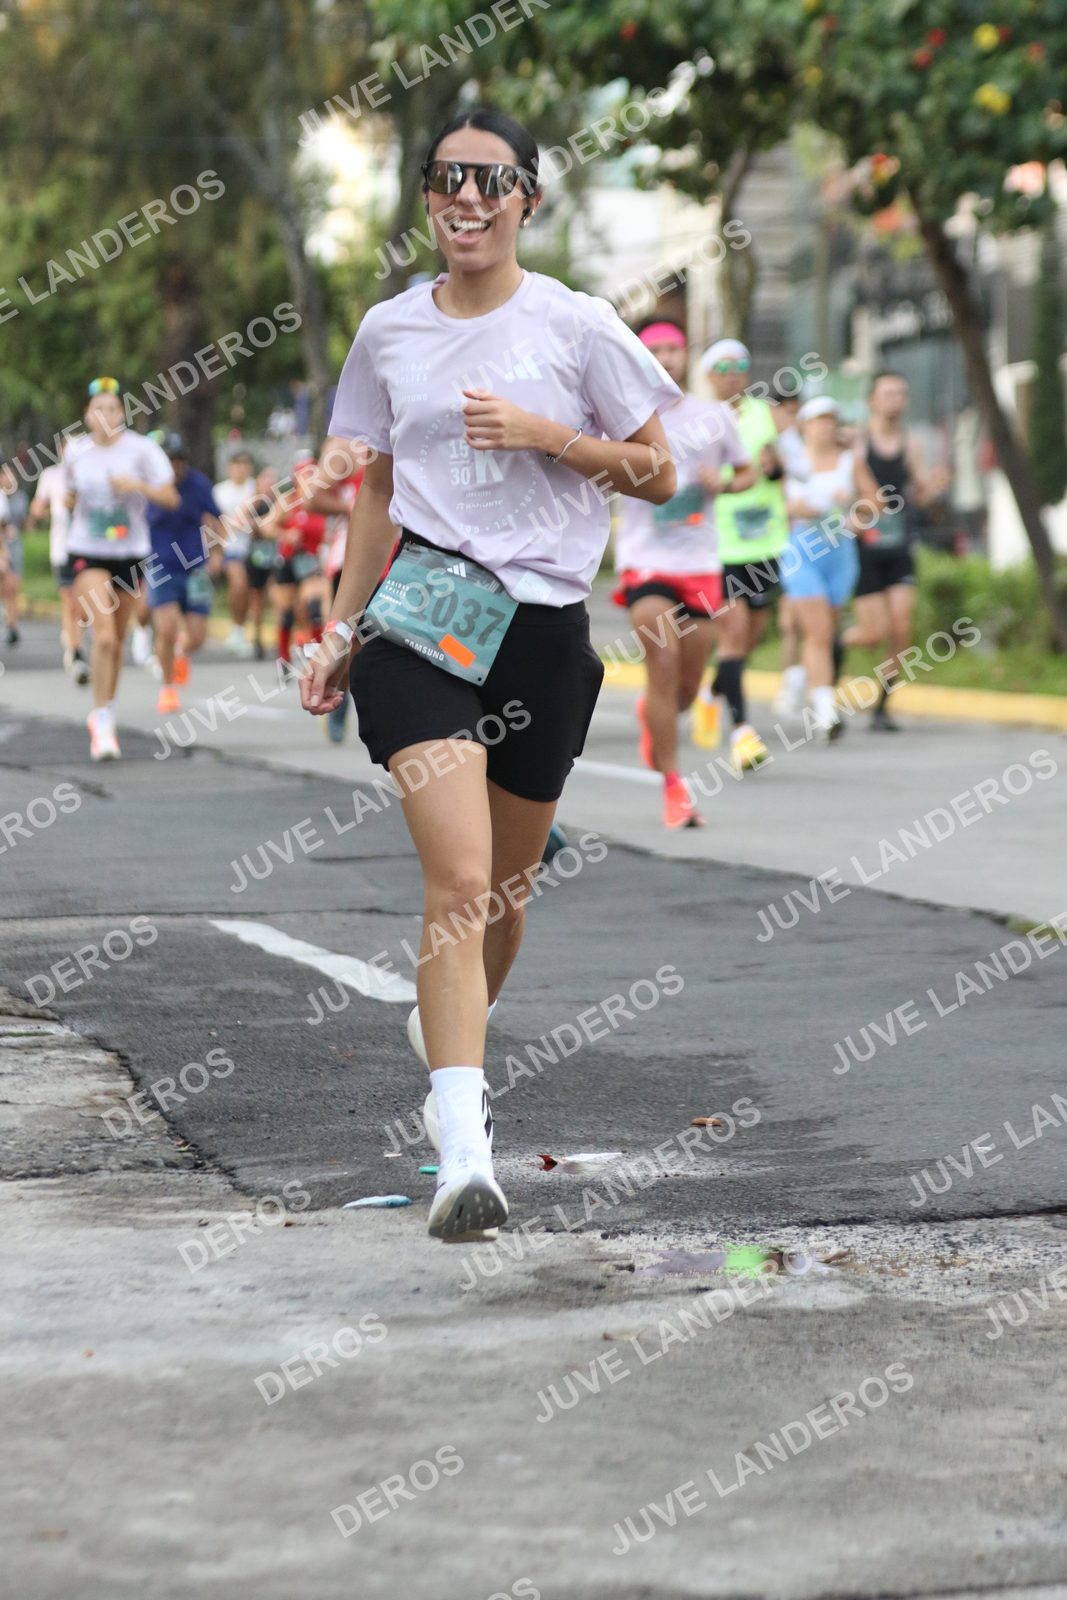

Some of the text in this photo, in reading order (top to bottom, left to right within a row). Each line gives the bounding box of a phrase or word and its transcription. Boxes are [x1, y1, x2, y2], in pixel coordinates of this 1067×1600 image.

[448, 439, 470, 459] 15
[449, 466, 471, 486] 30
[474, 449, 504, 484] K
[408, 584, 506, 648] 1037
